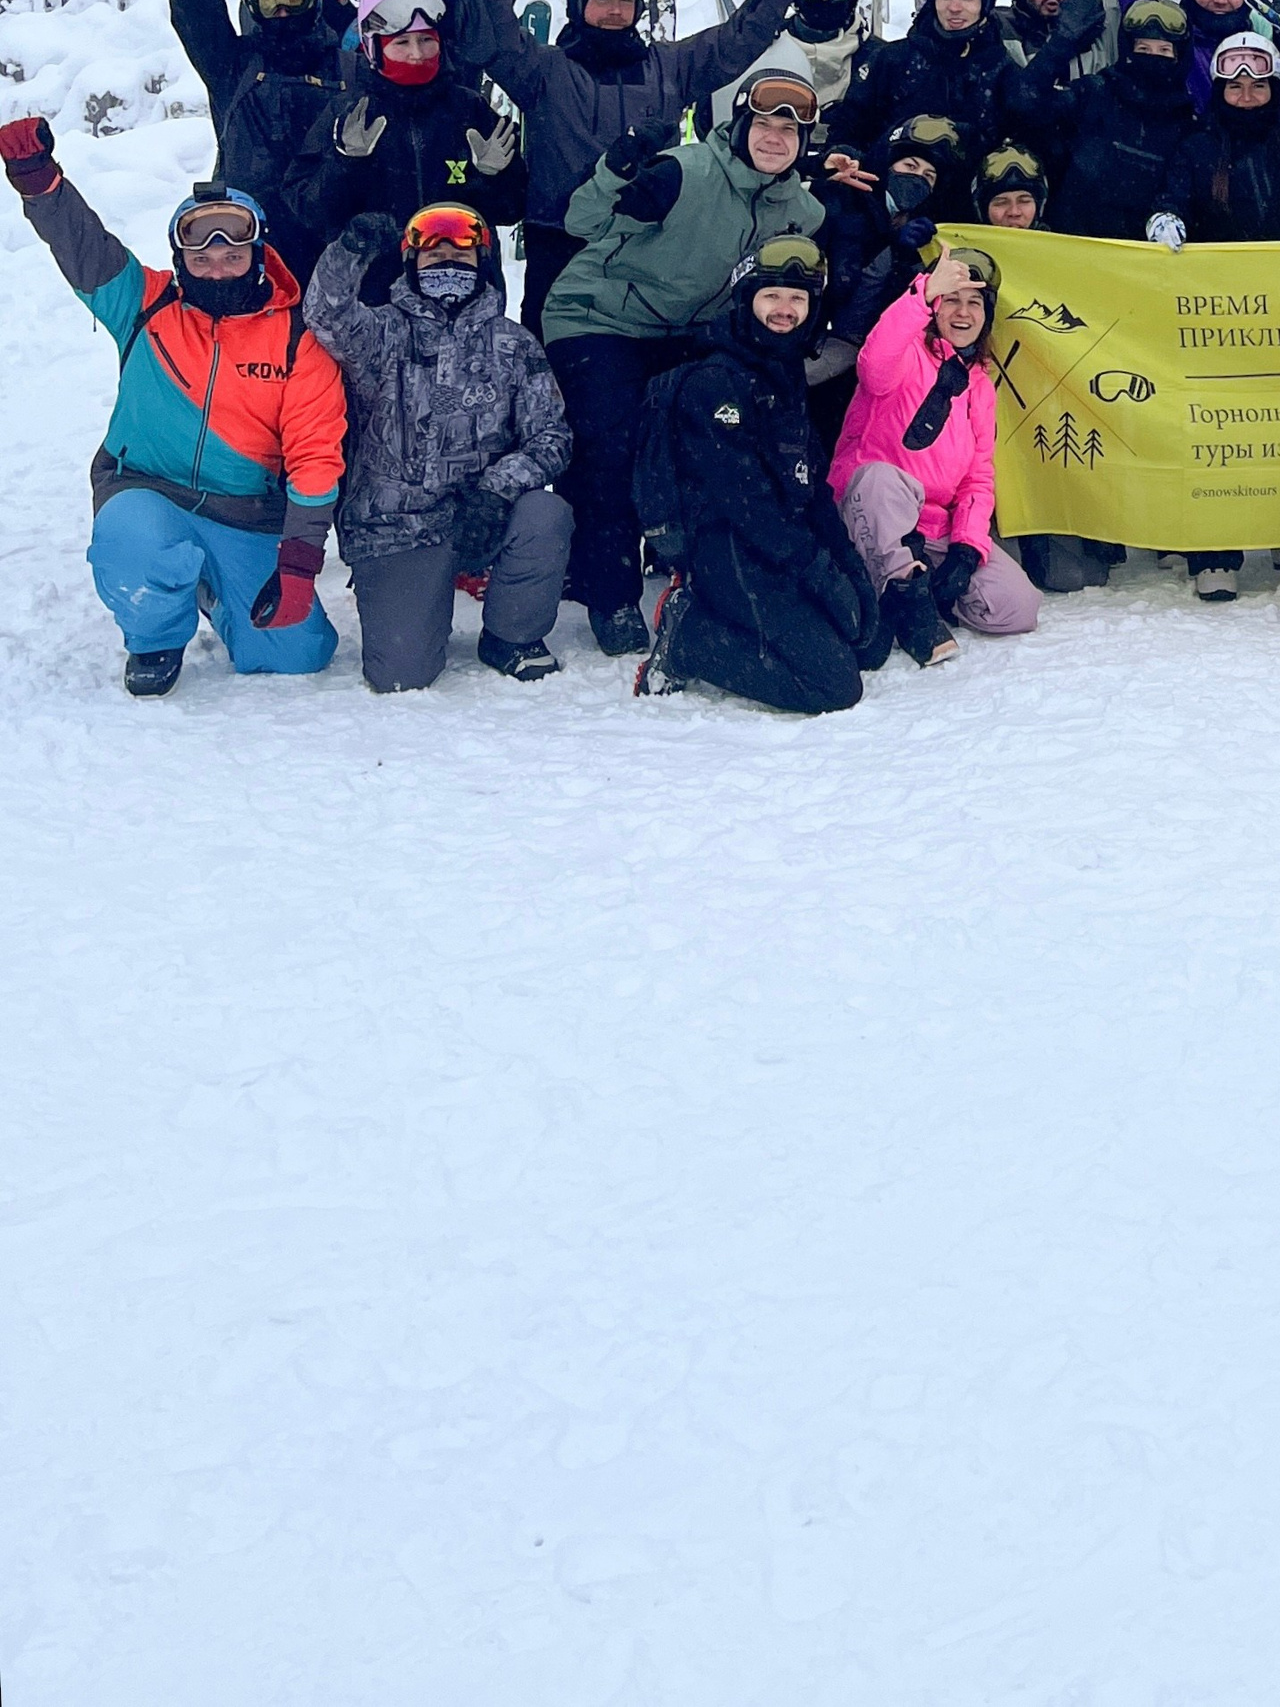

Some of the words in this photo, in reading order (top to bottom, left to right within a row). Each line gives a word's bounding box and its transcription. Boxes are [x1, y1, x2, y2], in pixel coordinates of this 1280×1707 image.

[1175, 294, 1269, 316] ВРЕМЯ
[1191, 443, 1254, 467] туры
[1191, 485, 1278, 499] @snowskitours
